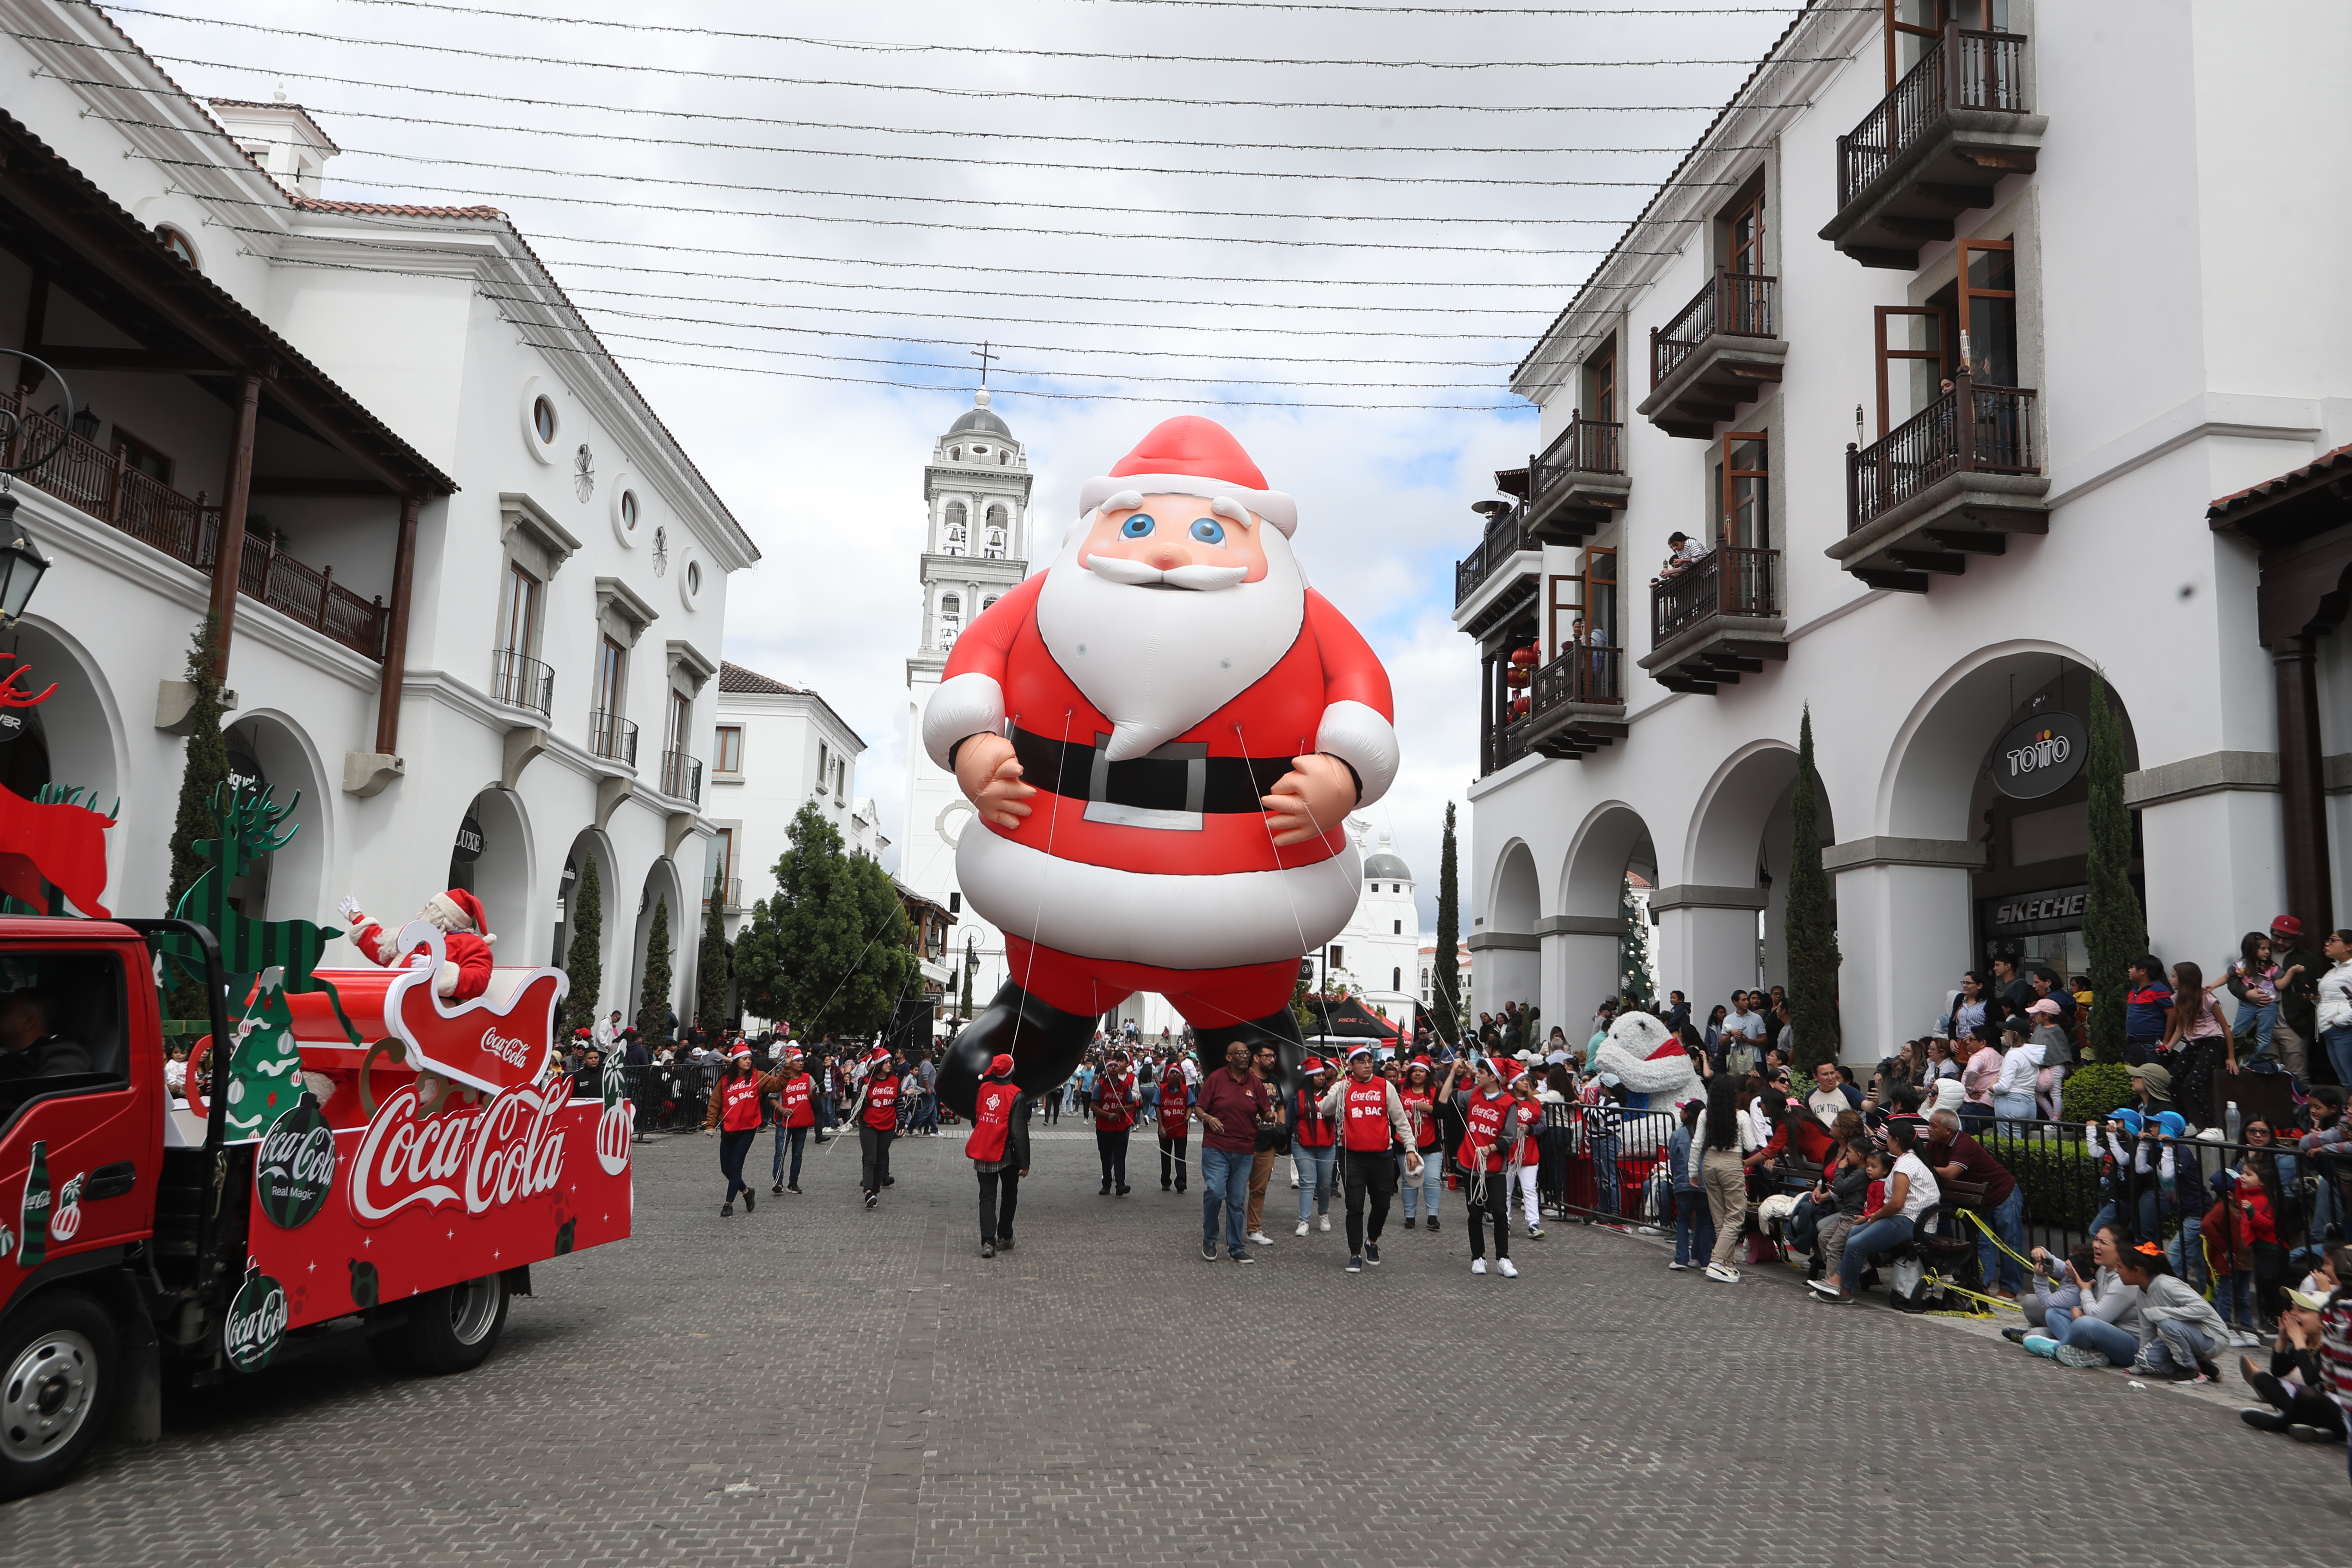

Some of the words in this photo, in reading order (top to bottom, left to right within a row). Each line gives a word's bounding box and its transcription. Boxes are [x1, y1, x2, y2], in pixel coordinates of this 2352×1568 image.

[2007, 736, 2070, 776] TOTTO
[481, 1026, 531, 1069] Coca-Cola
[786, 1082, 807, 1093] Coca-Cola
[873, 1086, 894, 1095] Coca-Cola
[739, 1090, 754, 1100] BAC
[1351, 1090, 1381, 1102] Coca-Cola
[1365, 1106, 1382, 1116] BAC
[1472, 1104, 1500, 1122] Coca-Cola
[1478, 1123, 1497, 1137] BAC
[354, 1081, 572, 1219] Coca-Cola
[272, 1185, 288, 1197] Real
